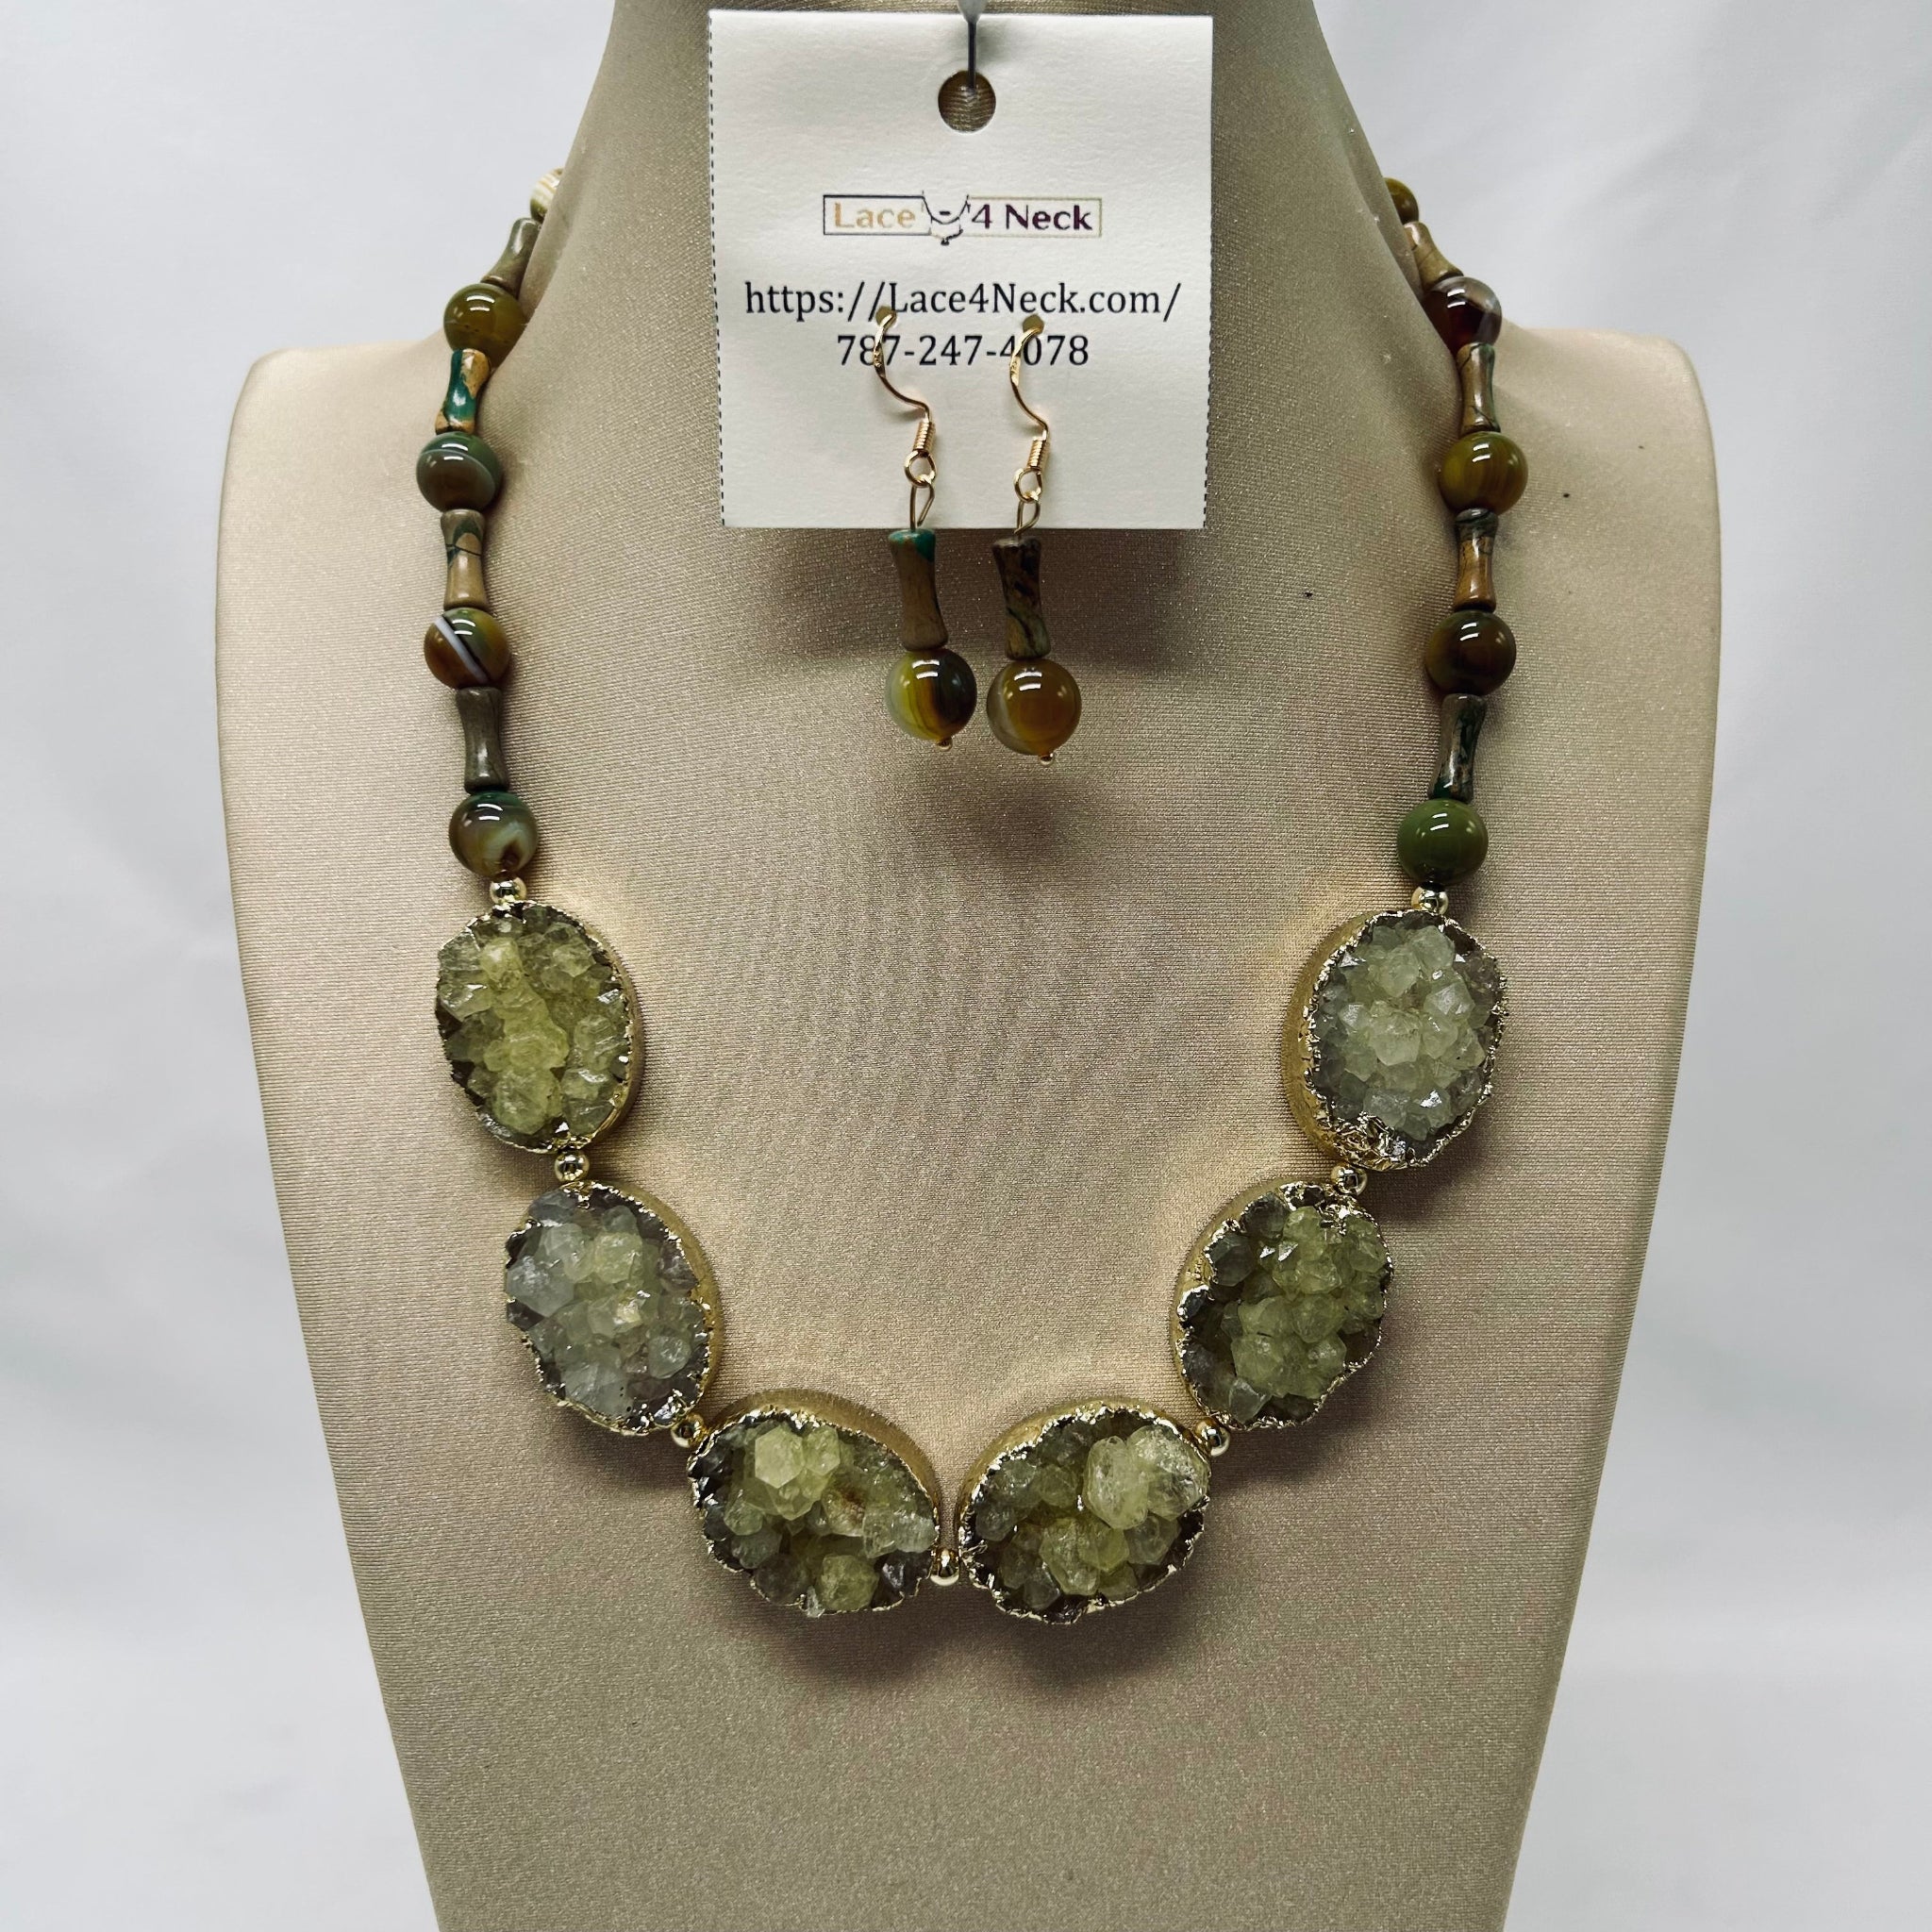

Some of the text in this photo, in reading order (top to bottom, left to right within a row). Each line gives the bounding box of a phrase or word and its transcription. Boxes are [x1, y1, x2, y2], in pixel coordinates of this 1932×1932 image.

[834, 203, 1093, 231] Lace 4 Neck
[744, 281, 1181, 323] https://Lace4Neck.com/
[837, 335, 1089, 367] 787-247-4078
